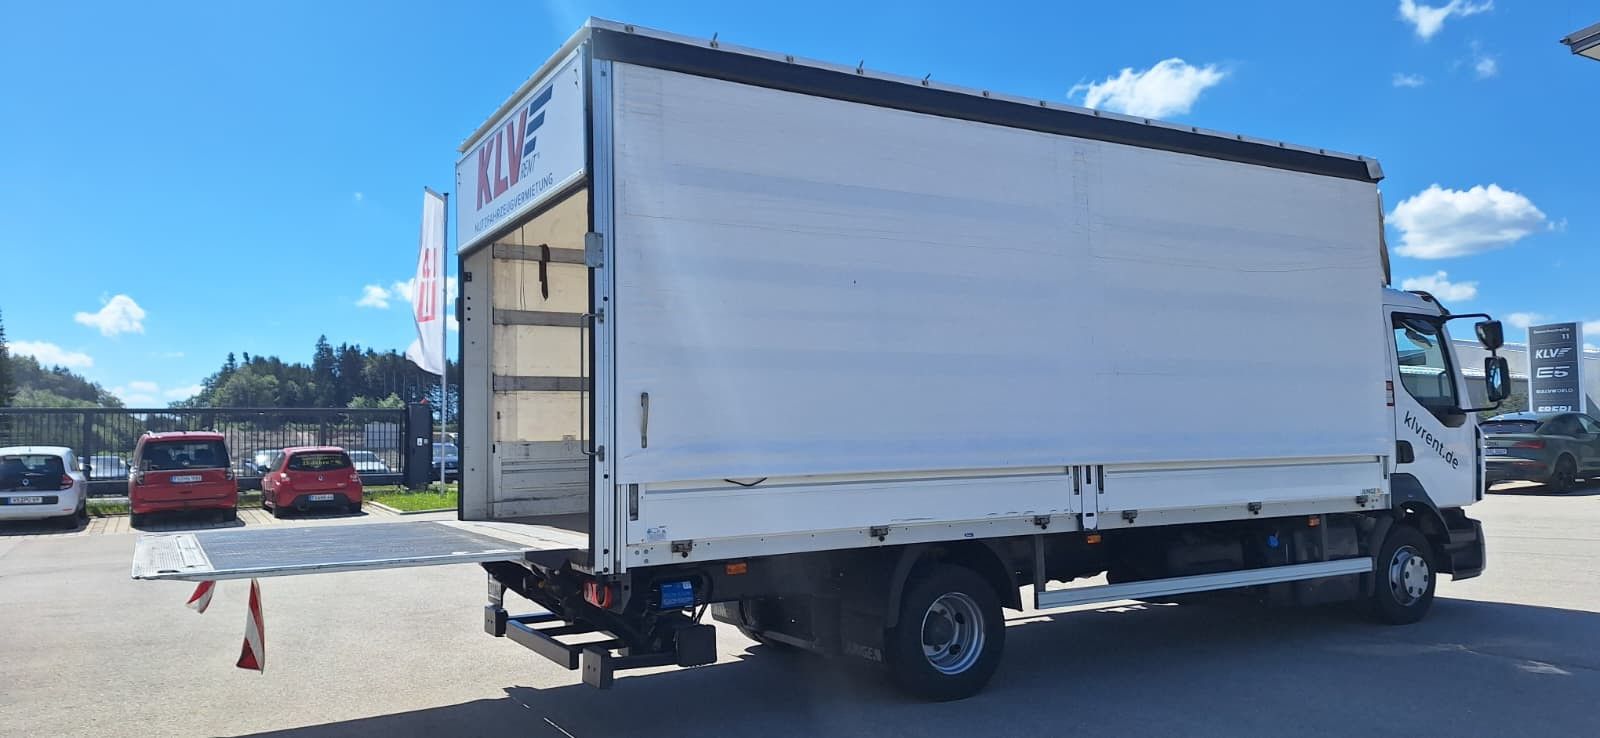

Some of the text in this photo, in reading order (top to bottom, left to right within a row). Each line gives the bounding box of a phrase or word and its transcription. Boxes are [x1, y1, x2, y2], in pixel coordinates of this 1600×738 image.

[476, 107, 529, 212] KLV
[474, 172, 554, 232] NUTZFAHRZEUGVERMIETUNG
[1535, 348, 1560, 359] KLV
[1403, 410, 1460, 470] klvrent.de
